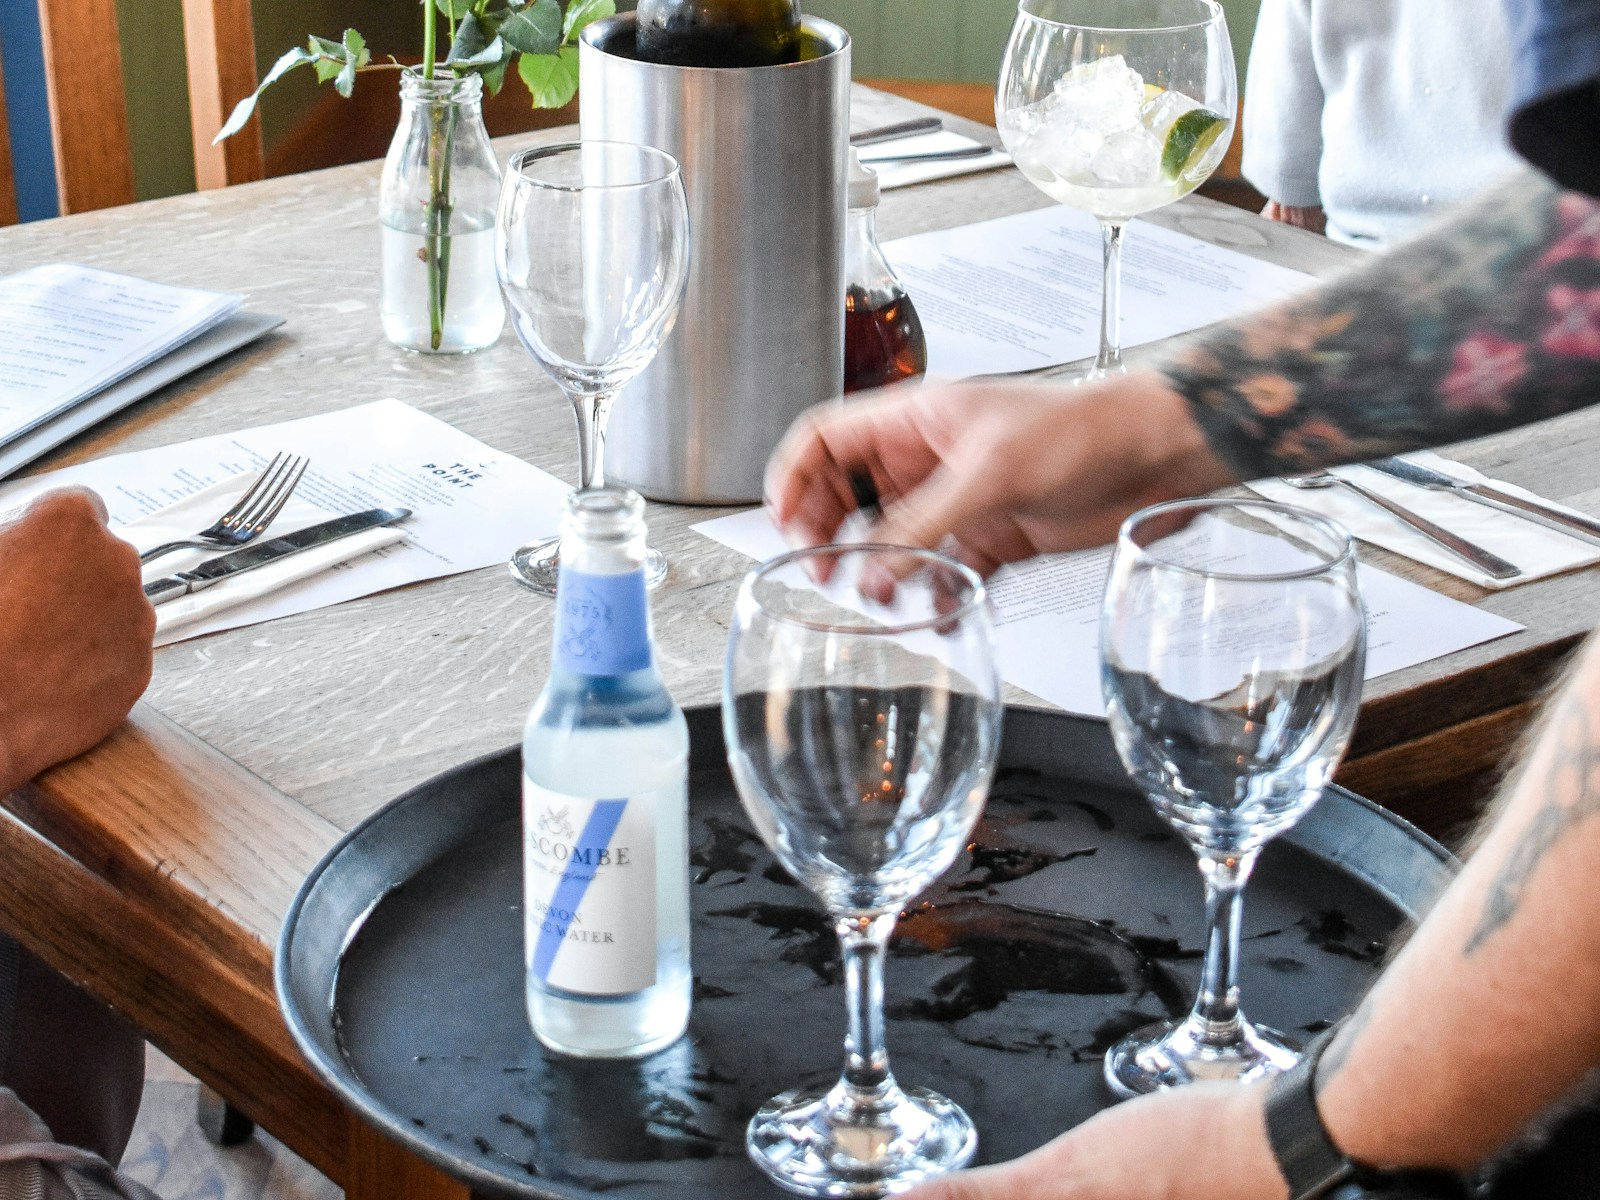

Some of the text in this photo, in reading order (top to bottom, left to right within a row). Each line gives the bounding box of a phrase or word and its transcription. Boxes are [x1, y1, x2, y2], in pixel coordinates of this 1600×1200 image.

[421, 463, 474, 488] POINT
[449, 462, 483, 480] THE
[529, 830, 631, 866] SCOMBE
[534, 899, 582, 924] DEVON
[556, 924, 615, 943] WATER
